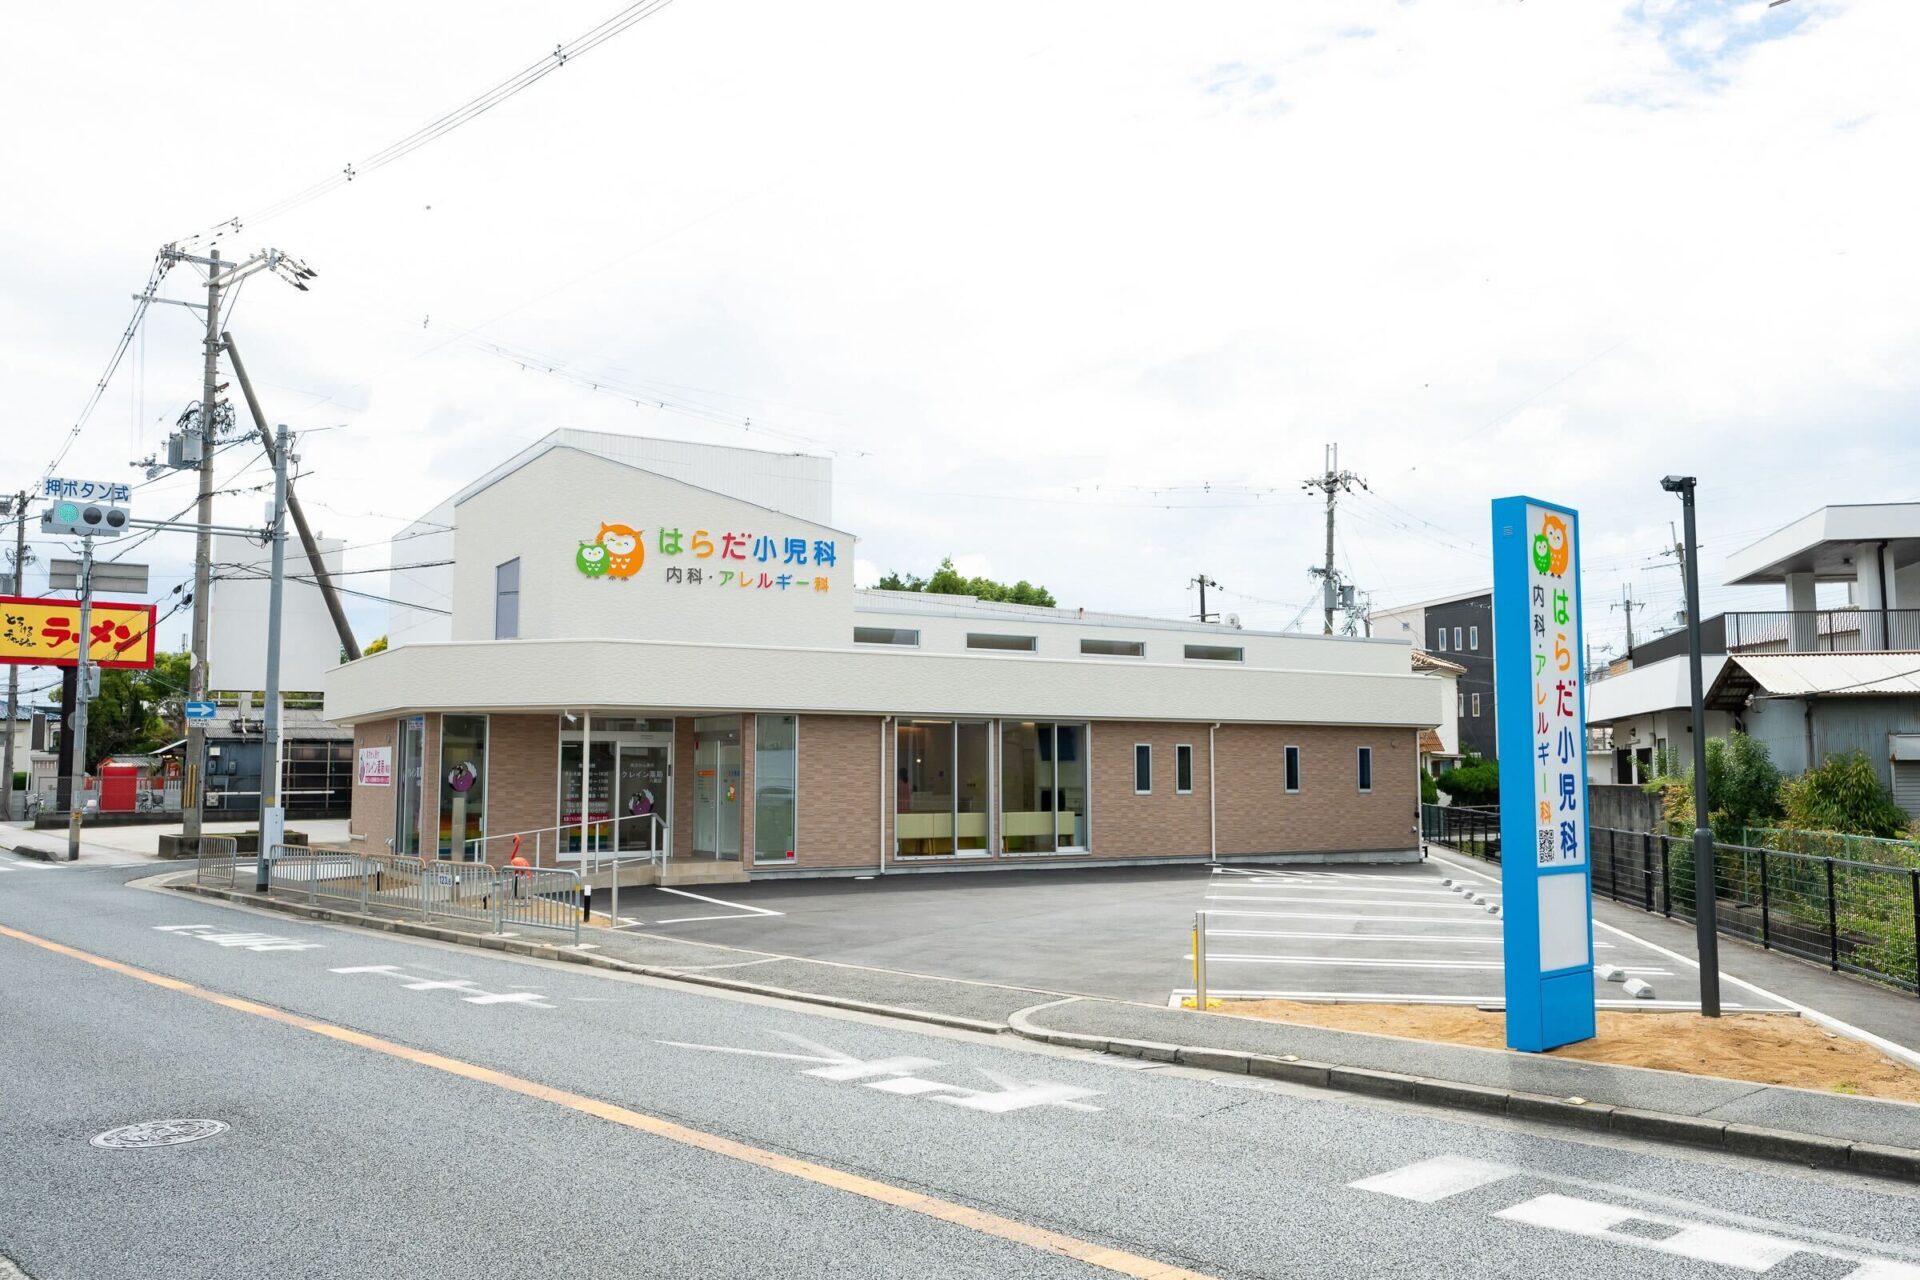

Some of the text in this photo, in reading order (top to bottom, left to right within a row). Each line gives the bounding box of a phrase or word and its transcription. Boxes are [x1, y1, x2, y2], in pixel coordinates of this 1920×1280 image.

[46, 478, 129, 501] 押ボタン式
[659, 527, 837, 567] はらだ小児科
[666, 567, 830, 593] 内科・アレルギー科
[1532, 584, 1552, 824] 内科・アレルギー科
[1553, 588, 1578, 859] はらだ小児科
